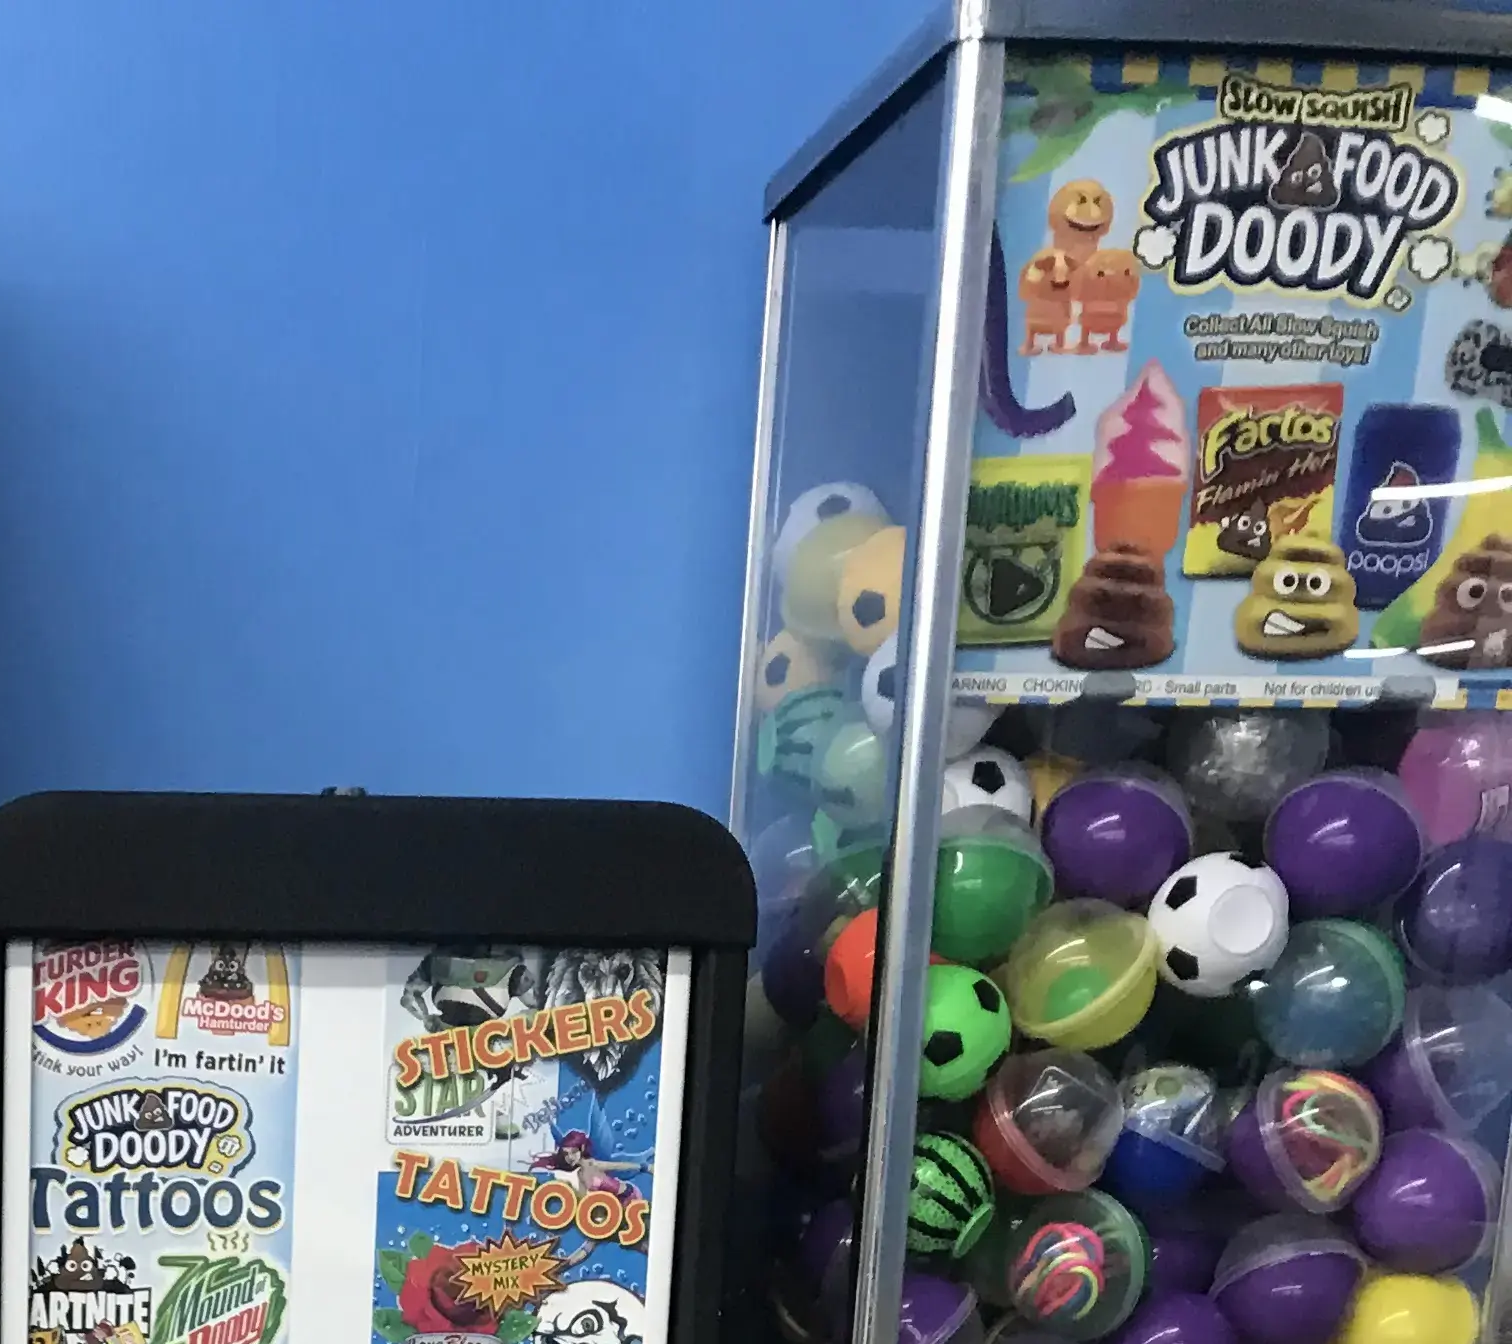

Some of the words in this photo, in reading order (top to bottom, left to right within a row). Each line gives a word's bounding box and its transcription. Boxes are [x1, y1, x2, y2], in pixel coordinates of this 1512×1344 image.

[1226, 80, 1296, 116] SLOW
[1304, 87, 1401, 124] SQUISH
[1157, 127, 1288, 213] JUNK
[1334, 131, 1452, 221] FOOD
[1185, 202, 1406, 288] DOODY
[1232, 342, 1278, 364] many
[1203, 407, 1336, 481] Fartos
[952, 678, 1007, 691] ARNING
[1164, 679, 1201, 694] Small
[1265, 681, 1288, 695] Not
[1291, 680, 1306, 695] for
[1311, 680, 1362, 696] children
[33, 939, 136, 986] TURDER
[34, 959, 140, 1022] KING
[183, 999, 285, 1022] McDood's
[199, 1016, 269, 1032] Hamturder
[394, 988, 656, 1088] STICKERS
[67, 1062, 104, 1079] your
[107, 1044, 144, 1073] way!
[154, 1047, 186, 1068] I'm
[196, 1050, 264, 1073] fartin'
[270, 1054, 286, 1075] it
[72, 1092, 141, 1139] JUNK
[168, 1091, 235, 1129] FOOD
[393, 1125, 485, 1137] ADVENTURER
[94, 1126, 211, 1168] DOODY
[31, 1167, 284, 1230] Tattoos
[394, 1150, 650, 1246] TATTOOS
[470, 1253, 540, 1276] MYSTERY
[493, 1276, 520, 1289] MIX
[29, 1289, 150, 1336] ARTNITE
[176, 1266, 257, 1337] Mound
